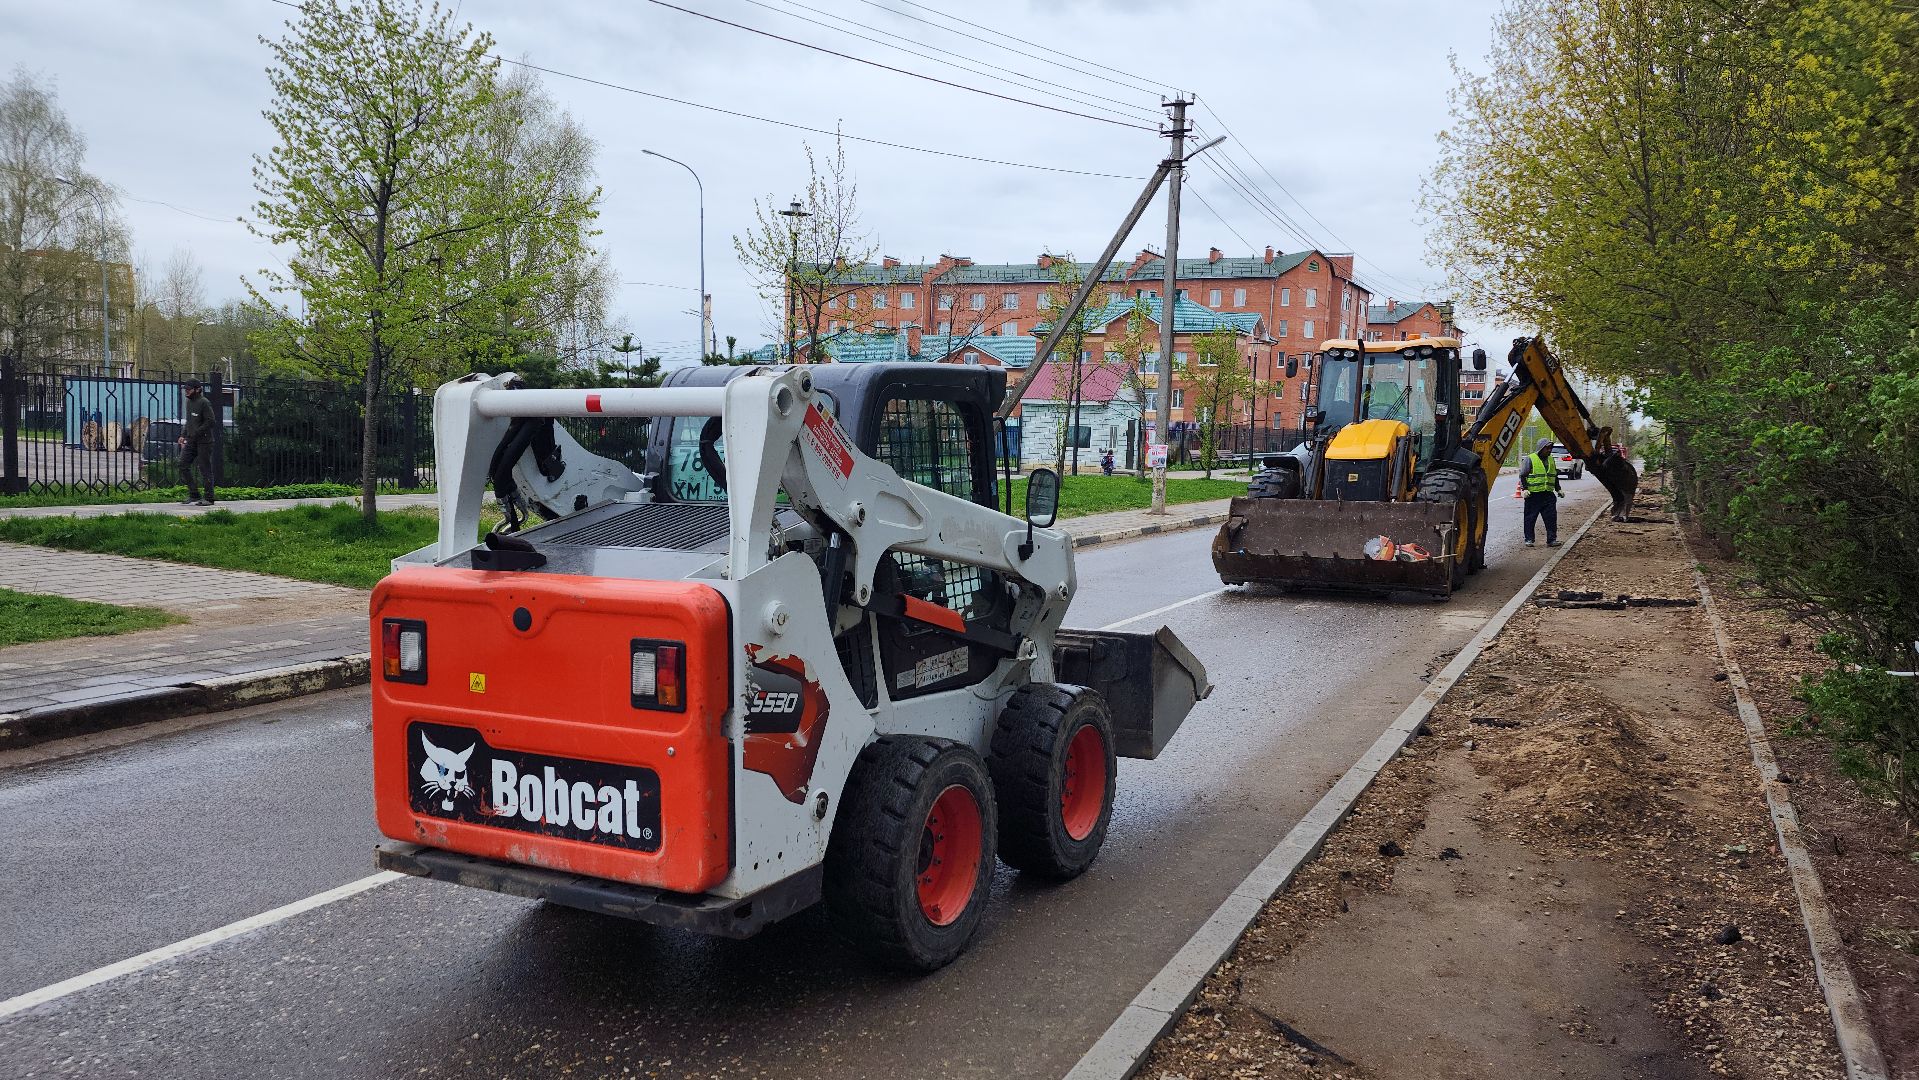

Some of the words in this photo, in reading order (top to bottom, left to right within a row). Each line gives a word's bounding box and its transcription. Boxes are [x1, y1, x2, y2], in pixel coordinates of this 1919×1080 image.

[1491, 410, 1522, 461] JCB
[750, 691, 799, 713] S530
[491, 758, 641, 839] Bobcat
